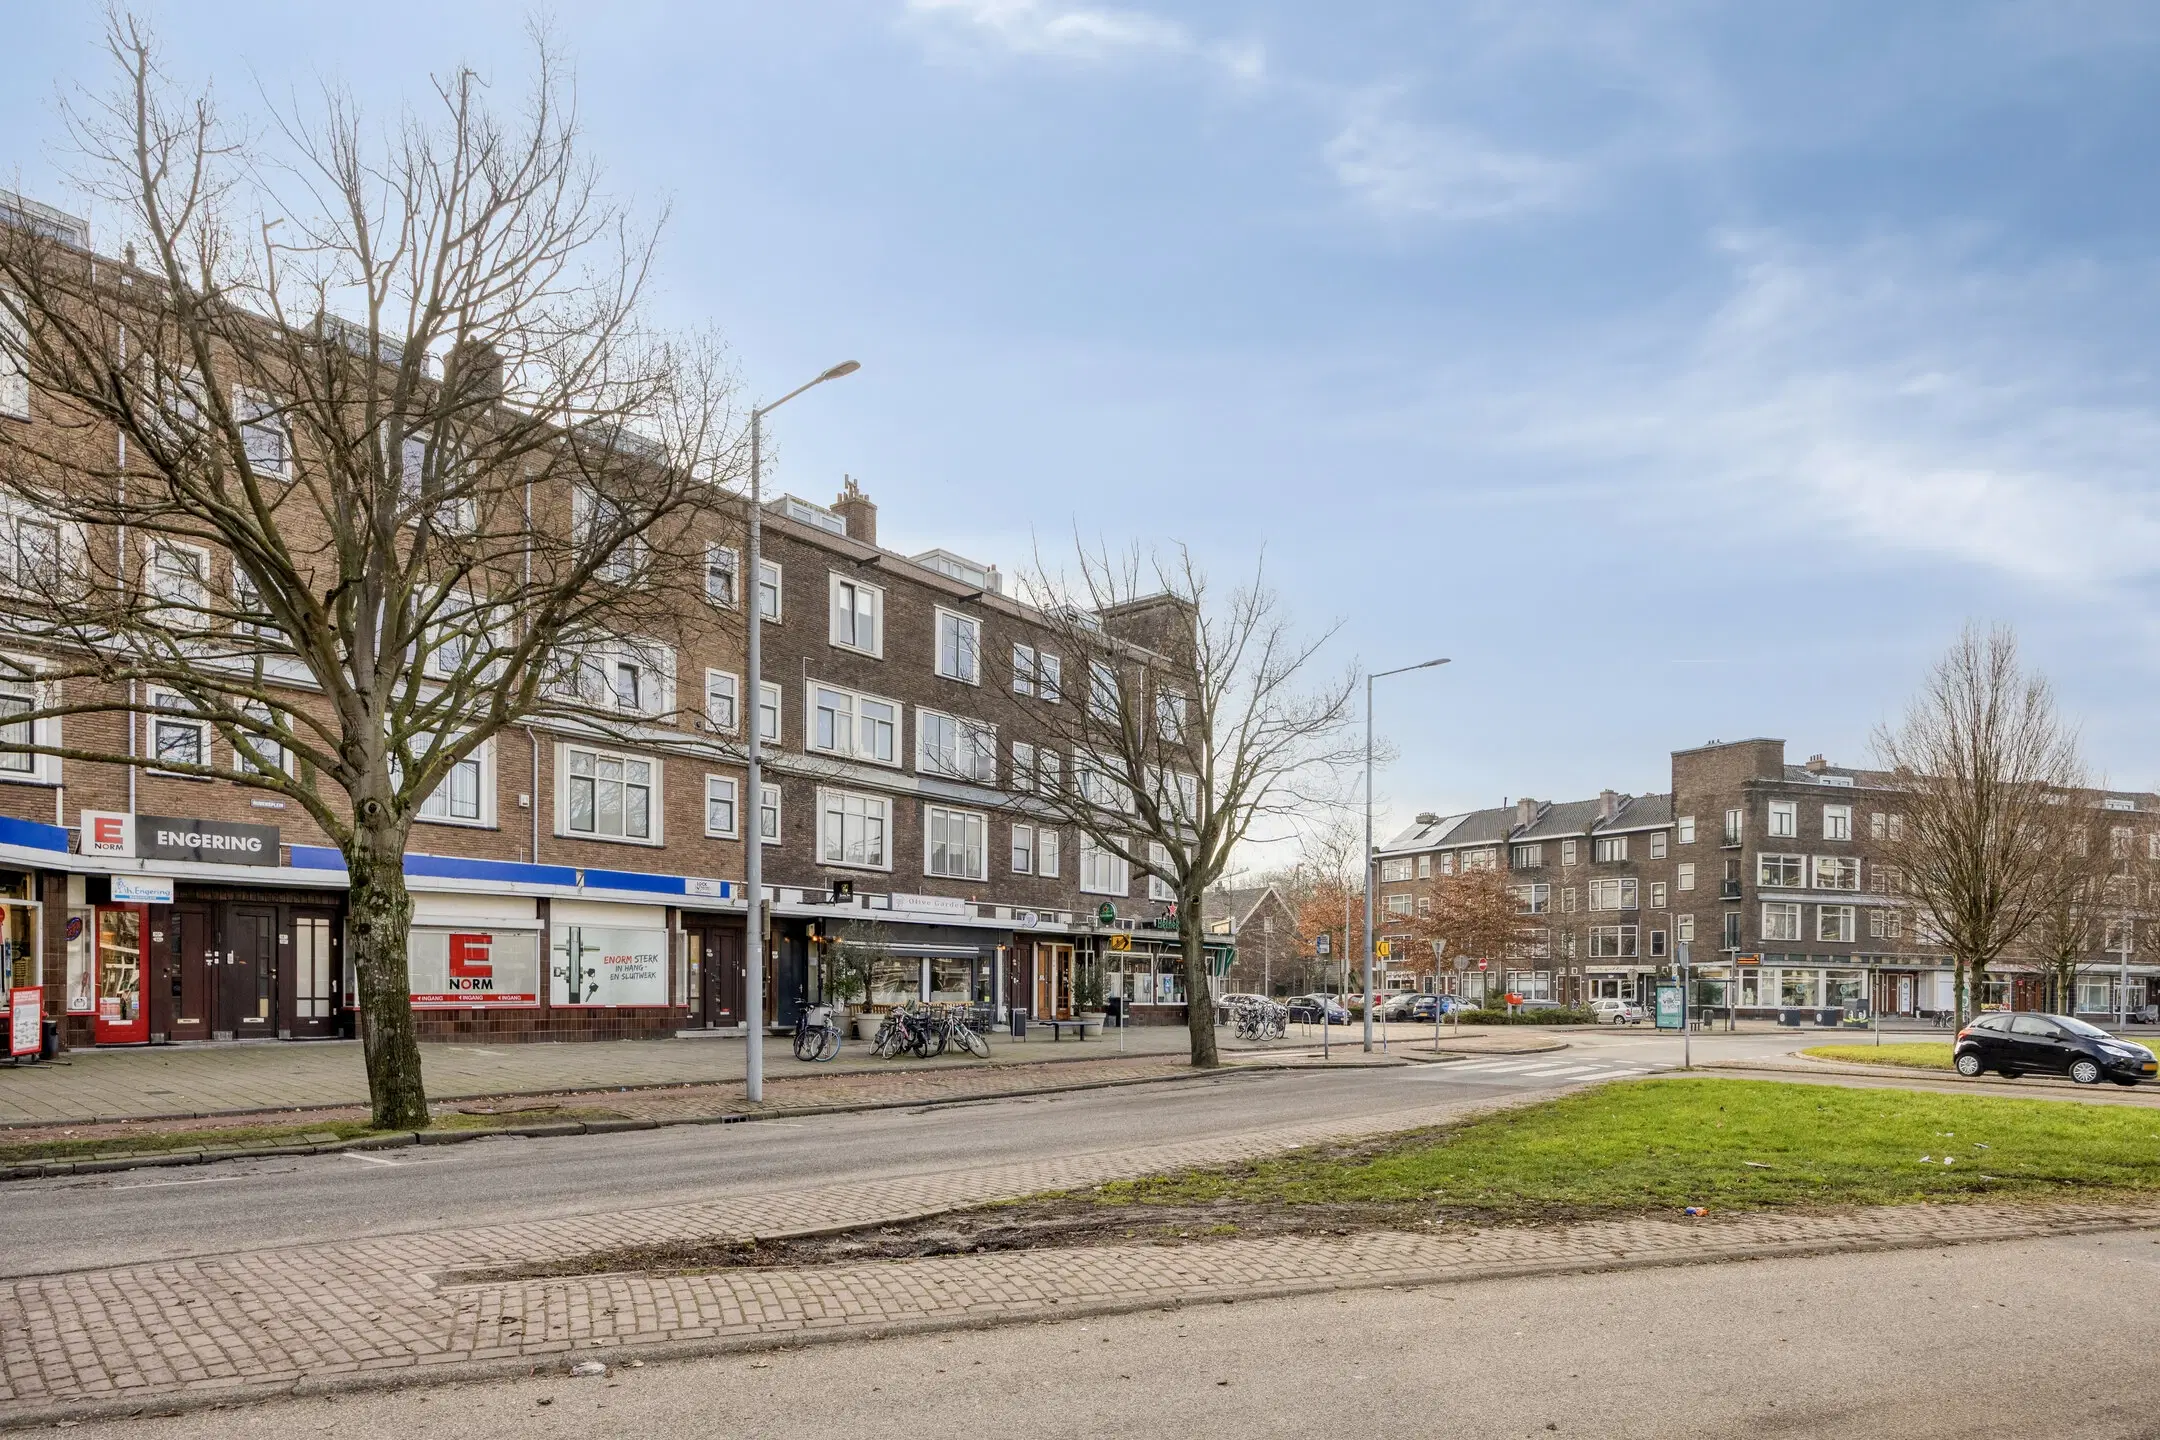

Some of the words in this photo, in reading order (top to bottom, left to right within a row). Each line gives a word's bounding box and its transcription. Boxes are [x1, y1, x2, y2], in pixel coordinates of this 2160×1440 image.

[95, 817, 123, 844] E
[157, 830, 262, 852] ENGERING
[94, 843, 124, 851] NORM
[934, 901, 965, 909] Garden
[449, 933, 493, 978] E
[603, 955, 633, 965] ENORM
[634, 954, 659, 964] STERK
[610, 973, 620, 981] EN
[621, 971, 657, 981] SLUITWERK
[449, 978, 494, 990] NORM
